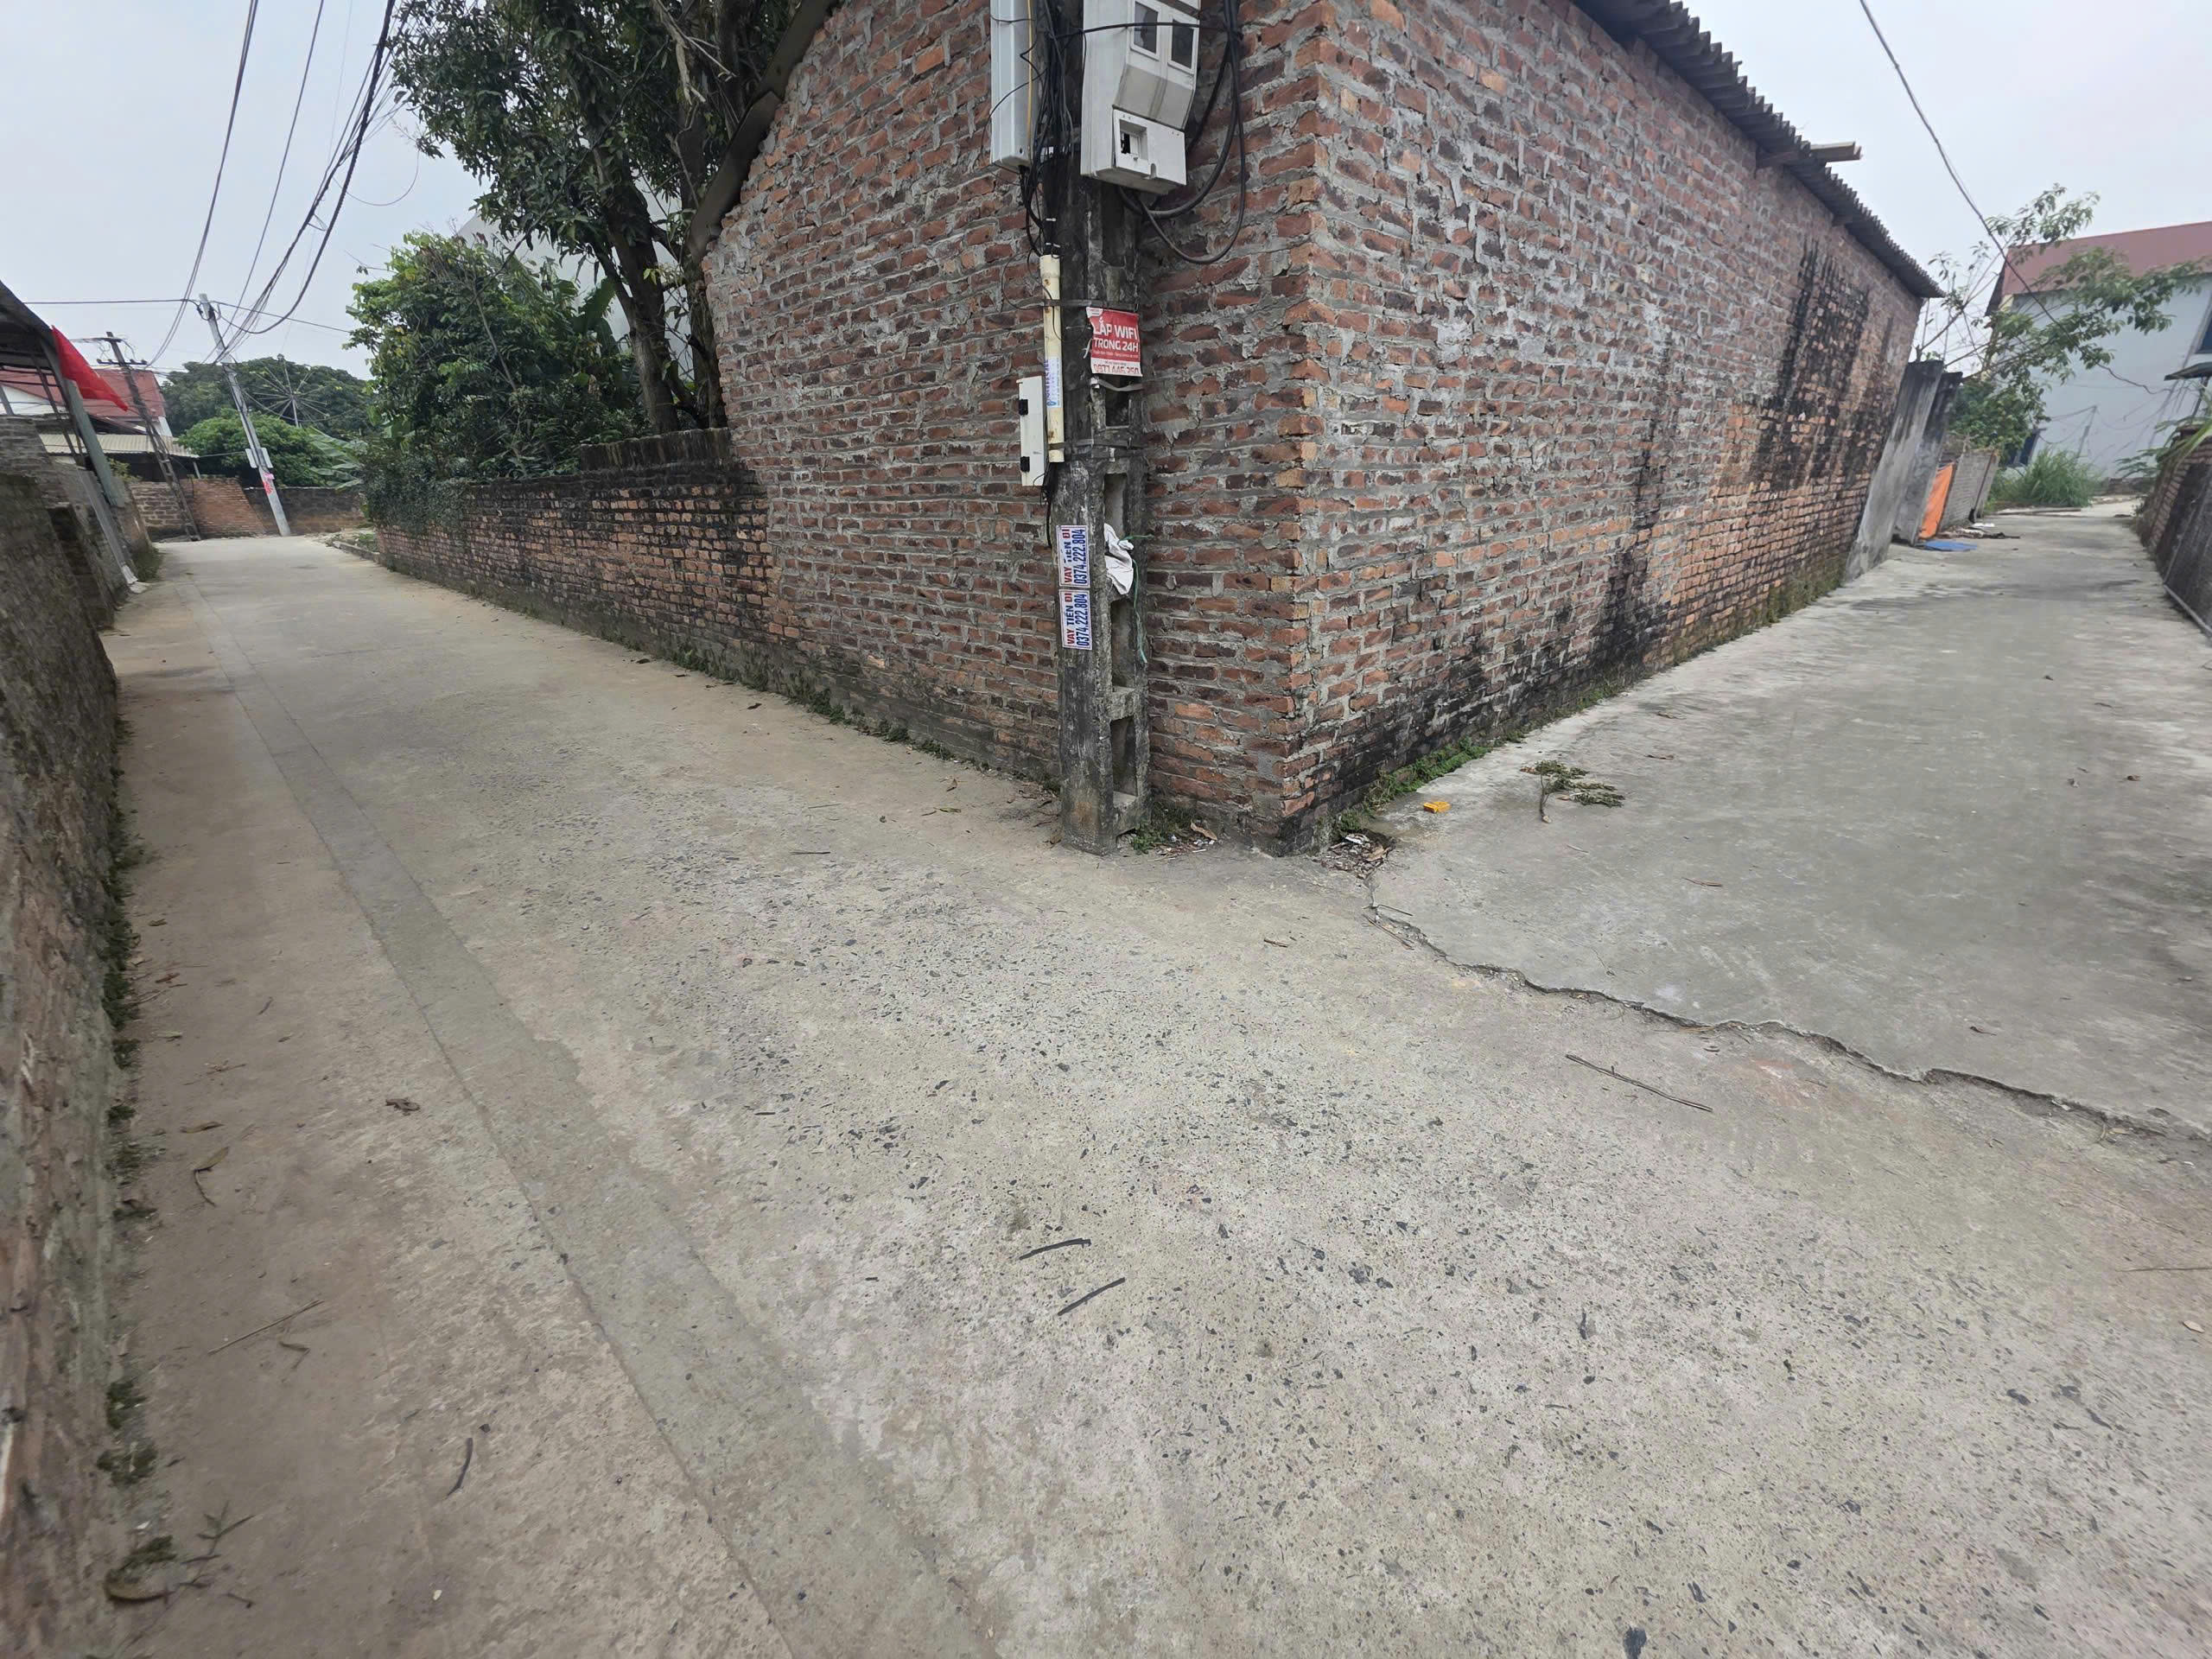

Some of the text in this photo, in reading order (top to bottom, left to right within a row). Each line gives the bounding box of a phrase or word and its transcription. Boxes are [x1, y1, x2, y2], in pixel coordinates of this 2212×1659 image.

[1093, 316, 1138, 340] LẮP WIFI
[1093, 338, 1139, 353] TRONG 24H
[1071, 529, 1088, 584] 0374.222.804
[1064, 567, 1072, 583] VAY
[1074, 594, 1090, 646] 0374.222.804
[1066, 628, 1075, 645] VAY
